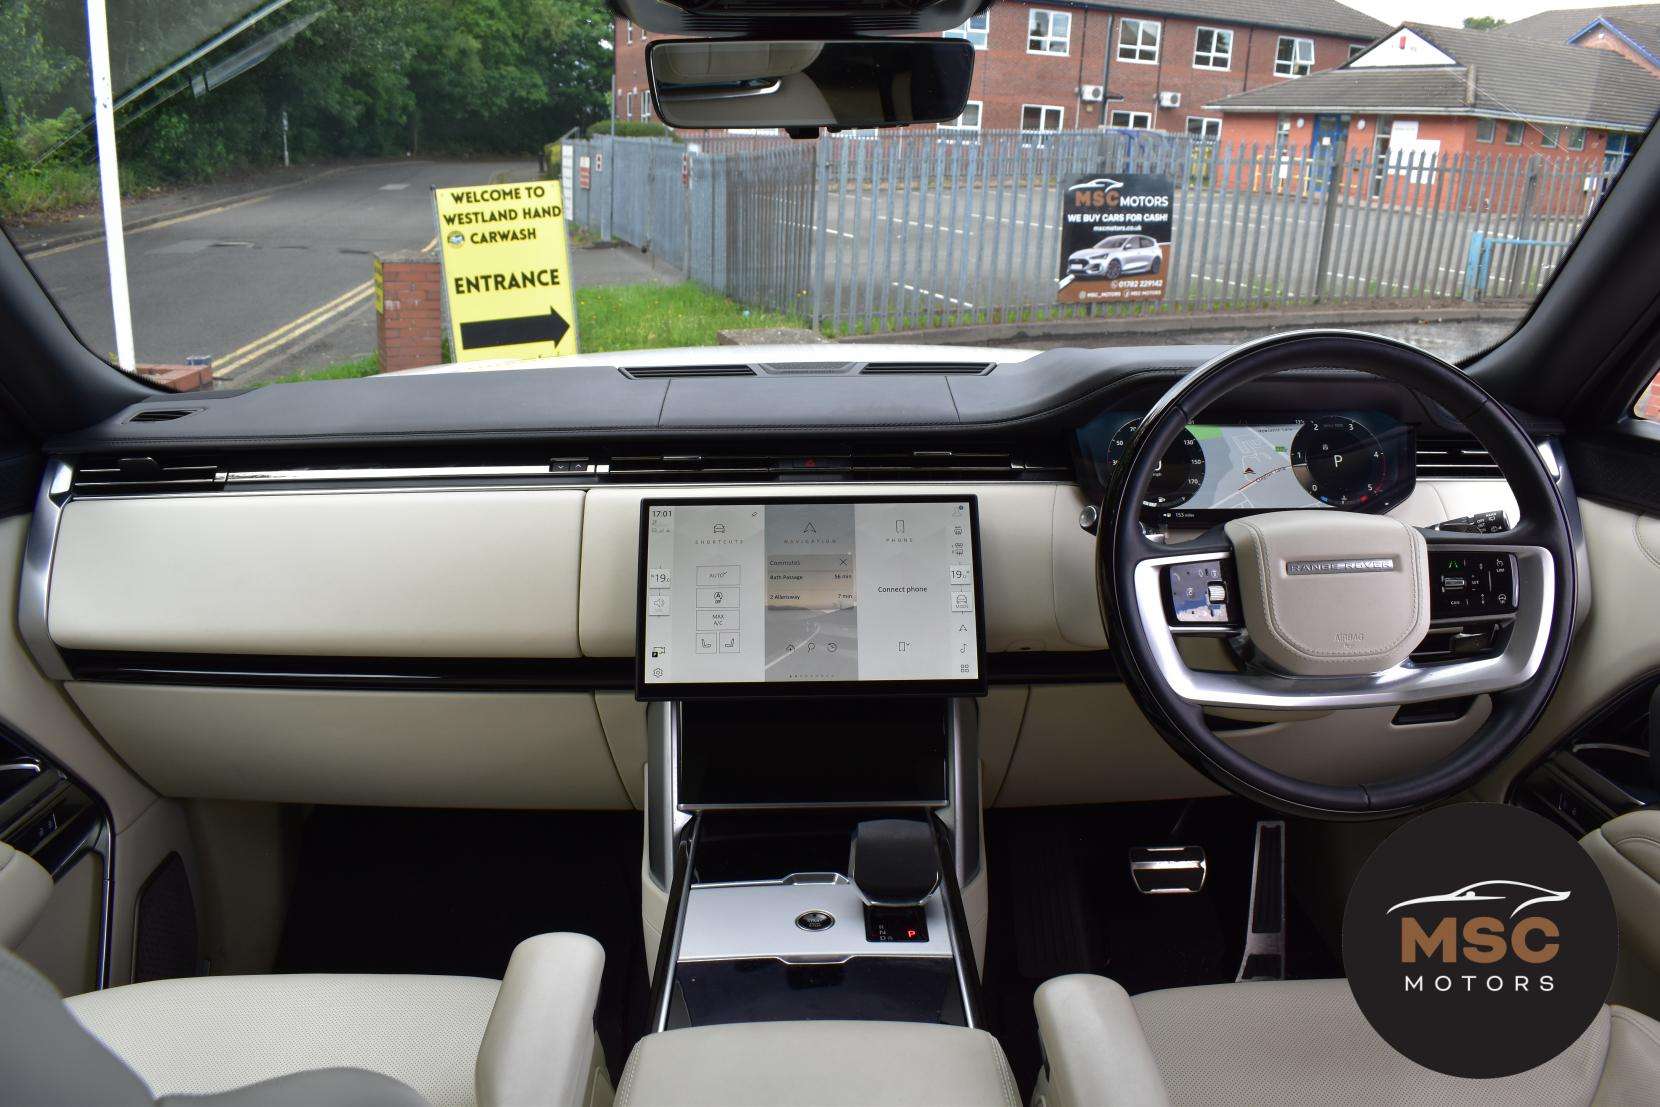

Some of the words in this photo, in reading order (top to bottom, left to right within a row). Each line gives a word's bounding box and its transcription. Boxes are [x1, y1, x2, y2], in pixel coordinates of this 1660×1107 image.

[451, 189, 521, 204] WELCOME
[525, 186, 545, 199] TO
[1075, 190, 1119, 208] MSC
[1120, 196, 1169, 207] MOTORS
[443, 209, 518, 226] WESTLAND
[522, 205, 562, 219] HAND
[1067, 214, 1081, 222] WE
[1083, 214, 1100, 222] BUY
[1102, 213, 1124, 222] CARS
[1126, 213, 1142, 221] FOR
[1143, 213, 1168, 221] CASH!
[470, 228, 537, 244] CARWASH
[454, 269, 560, 295] ENTRANCE
[1333, 454, 1344, 468] P
[1312, 484, 1318, 492] 0
[1367, 483, 1373, 491] 5
[1290, 563, 1340, 573] RANGE
[1345, 559, 1393, 569] ROVER
[906, 585, 928, 594] phone
[907, 930, 916, 938] P
